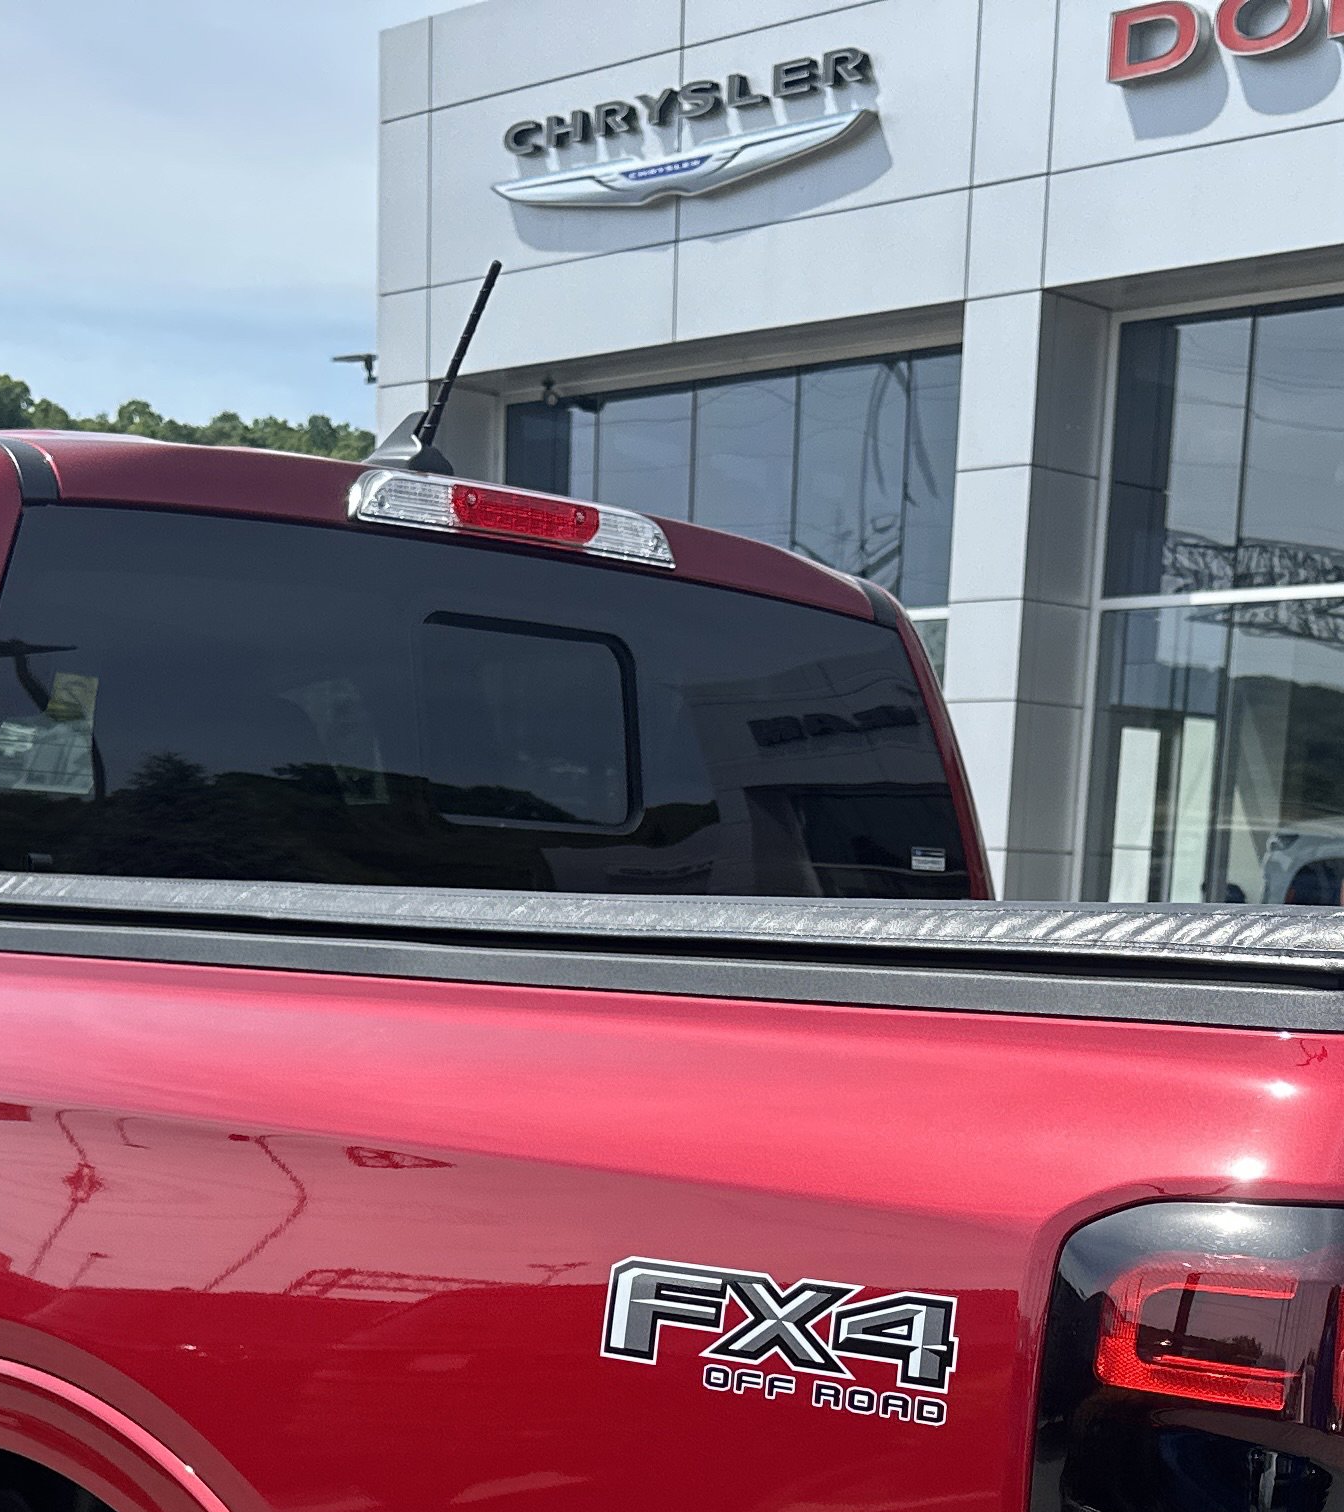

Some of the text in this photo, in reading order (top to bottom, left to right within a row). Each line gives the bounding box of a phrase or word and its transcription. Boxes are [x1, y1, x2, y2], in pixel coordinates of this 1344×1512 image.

[504, 47, 872, 155] CHRYSLER
[600, 1255, 958, 1394] FX4
[702, 1363, 947, 1427] OFF ROAD
